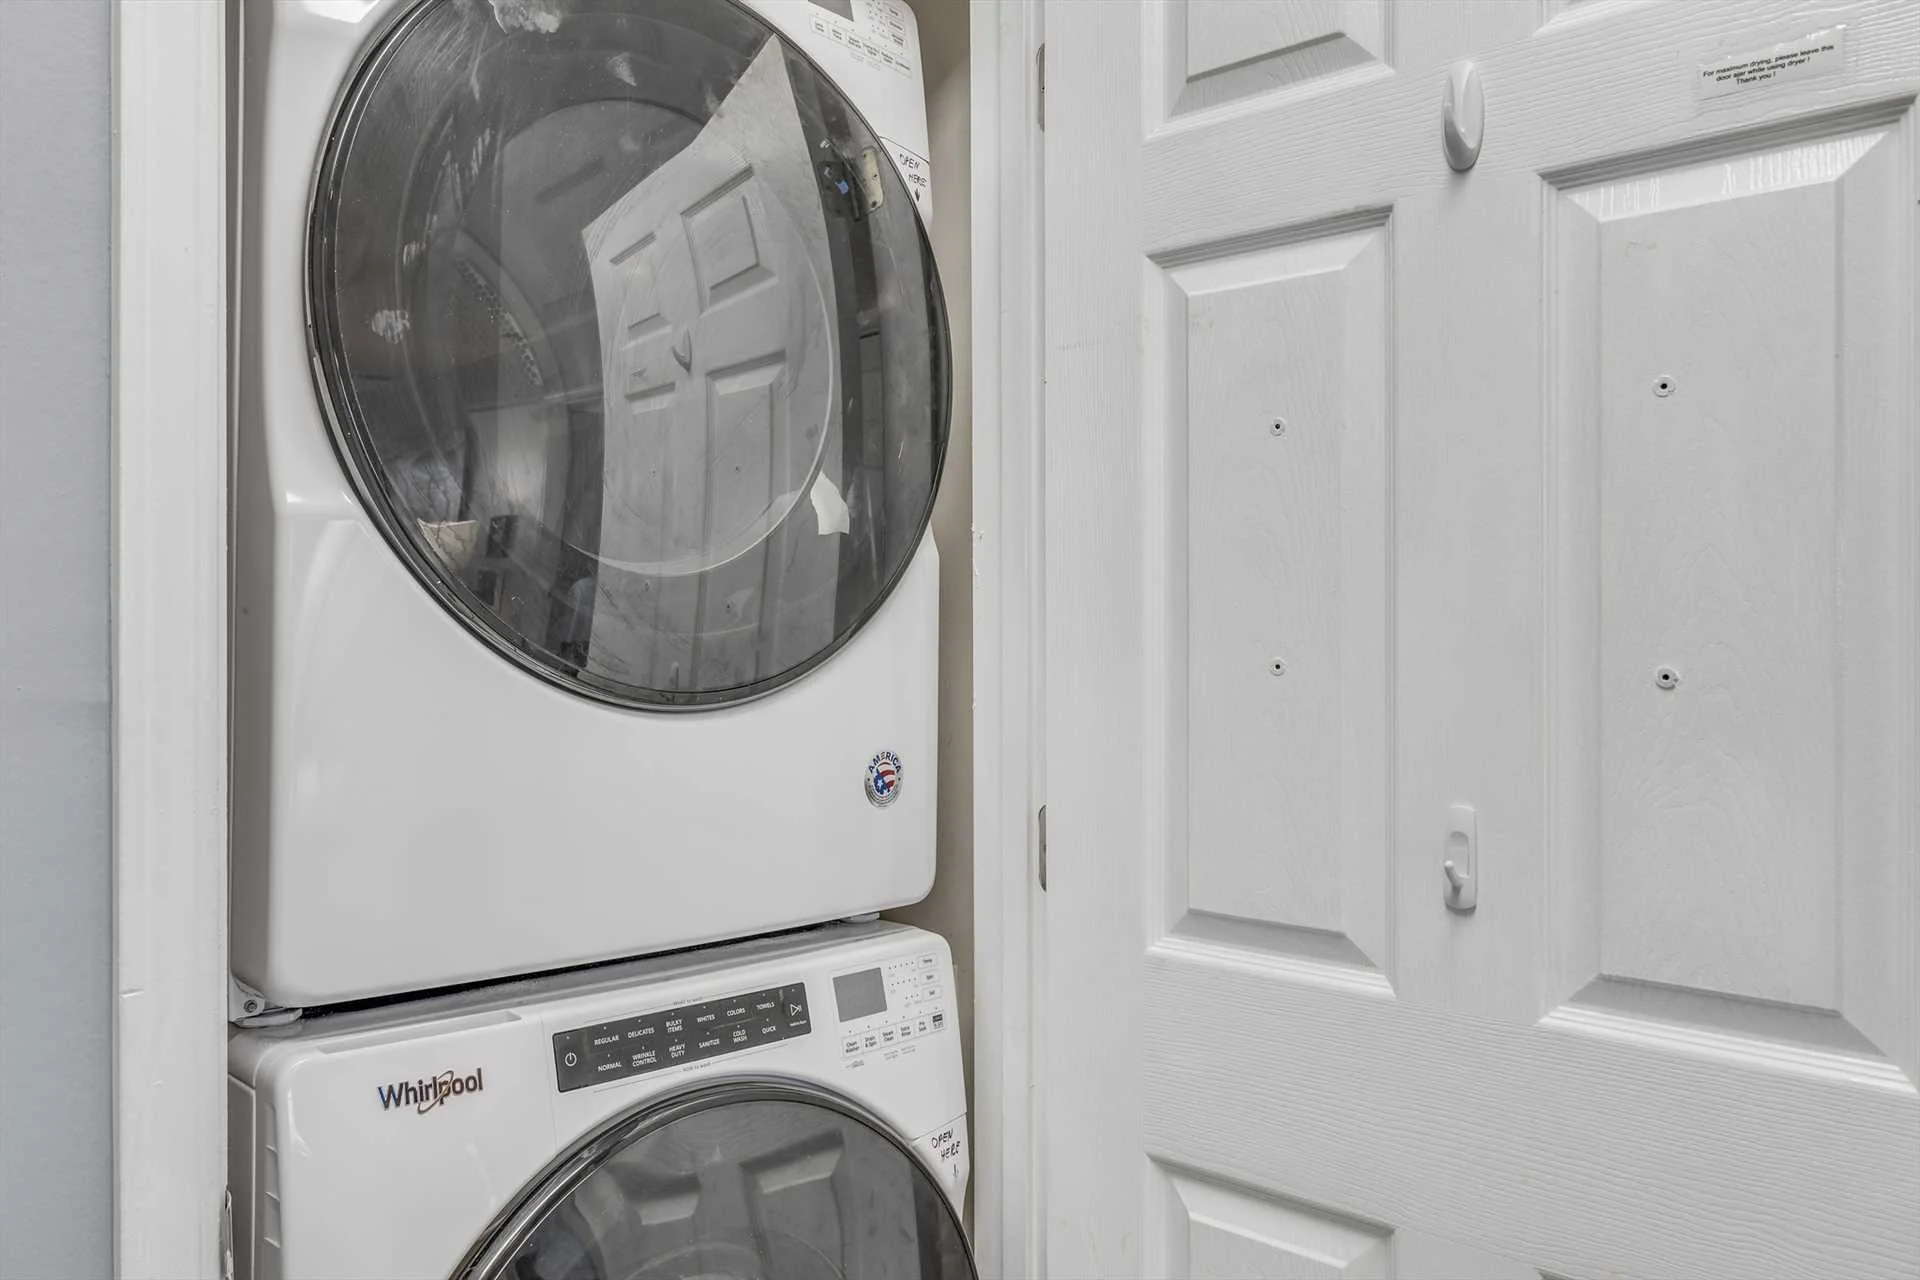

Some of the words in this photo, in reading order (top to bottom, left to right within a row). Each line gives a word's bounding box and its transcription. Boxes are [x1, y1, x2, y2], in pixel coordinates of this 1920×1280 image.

[1703, 70, 1714, 78] For
[1716, 64, 1748, 74] maximum
[1774, 52, 1798, 62] please
[1800, 48, 1819, 56] leave
[1821, 44, 1834, 52] this
[1716, 74, 1731, 82] door
[1733, 70, 1746, 79] ajar
[1748, 66, 1765, 75] while
[1767, 62, 1785, 70] using
[1787, 58, 1805, 67] dryer
[1736, 75, 1757, 84] Thank
[1759, 72, 1772, 81] you
[900, 153, 920, 169] OPEN
[868, 751, 901, 773] AMERICA
[756, 1002, 775, 1010] TOWELS
[727, 1007, 746, 1016] COLORS
[696, 1014, 715, 1022] WHITES
[666, 1019, 682, 1028] BULKY
[627, 1027, 655, 1038] DELICATES
[733, 1029, 746, 1038] COLD
[761, 1025, 776, 1034] QUICK
[594, 1034, 619, 1045] REGULAR
[699, 1038, 720, 1048] SANITIZE
[733, 1036, 748, 1044] WASH
[669, 1043, 686, 1052] HEAVY
[632, 1050, 656, 1060] WRINKLE
[671, 1050, 685, 1058] DUTY
[598, 1062, 622, 1072] NORMAL
[632, 1057, 657, 1067] CONTROL
[377, 1067, 483, 1111] Whirlpool
[931, 1127, 953, 1149] OPEN
[940, 1140, 960, 1162] HERE
